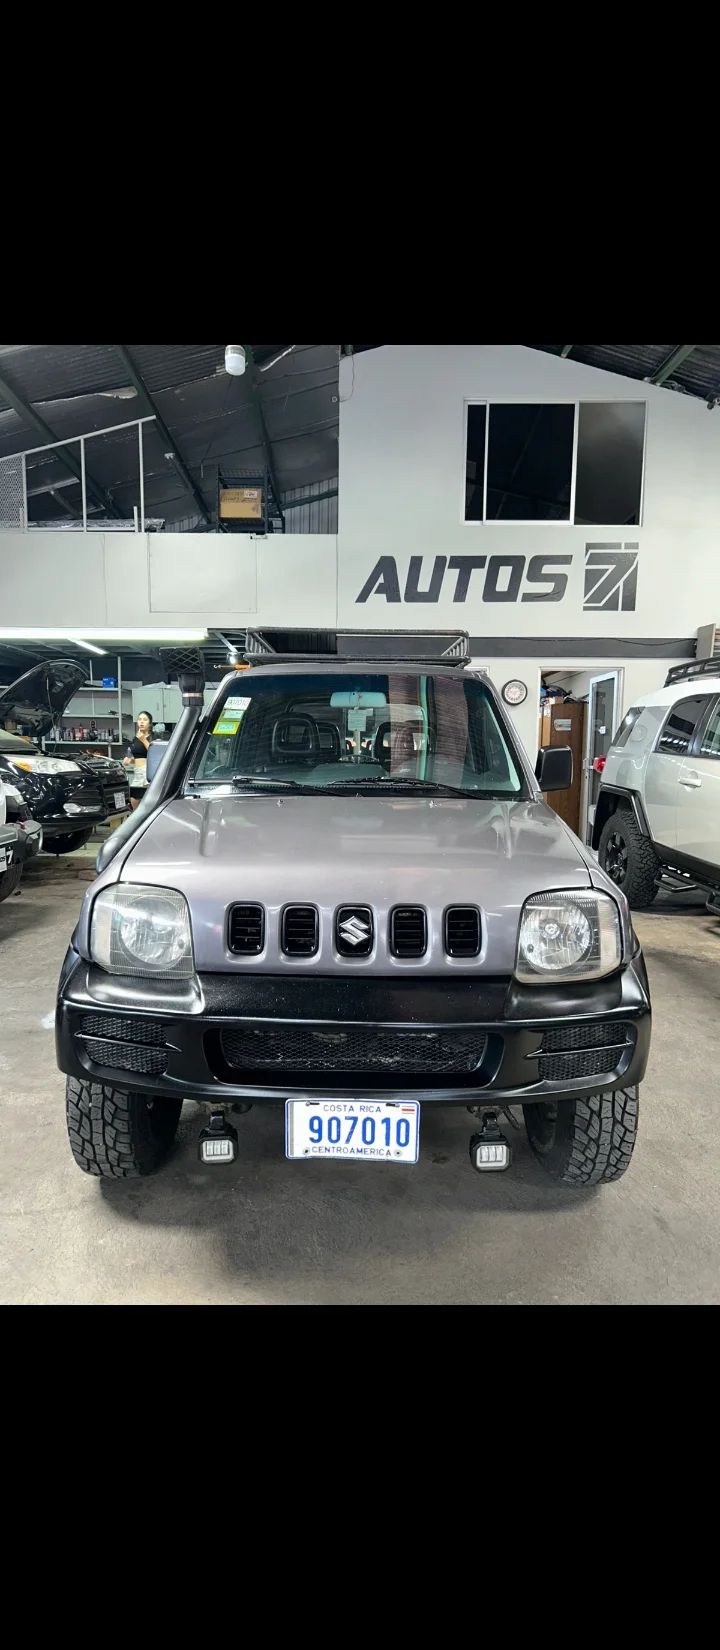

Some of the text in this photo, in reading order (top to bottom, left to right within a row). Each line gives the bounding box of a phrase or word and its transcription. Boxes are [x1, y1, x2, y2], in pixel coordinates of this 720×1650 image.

[355, 554, 573, 604] AUTOS
[323, 1104, 382, 1113] COSTA RICA
[308, 1115, 411, 1148] 907010
[311, 1146, 392, 1157] CENTROAMERICA
